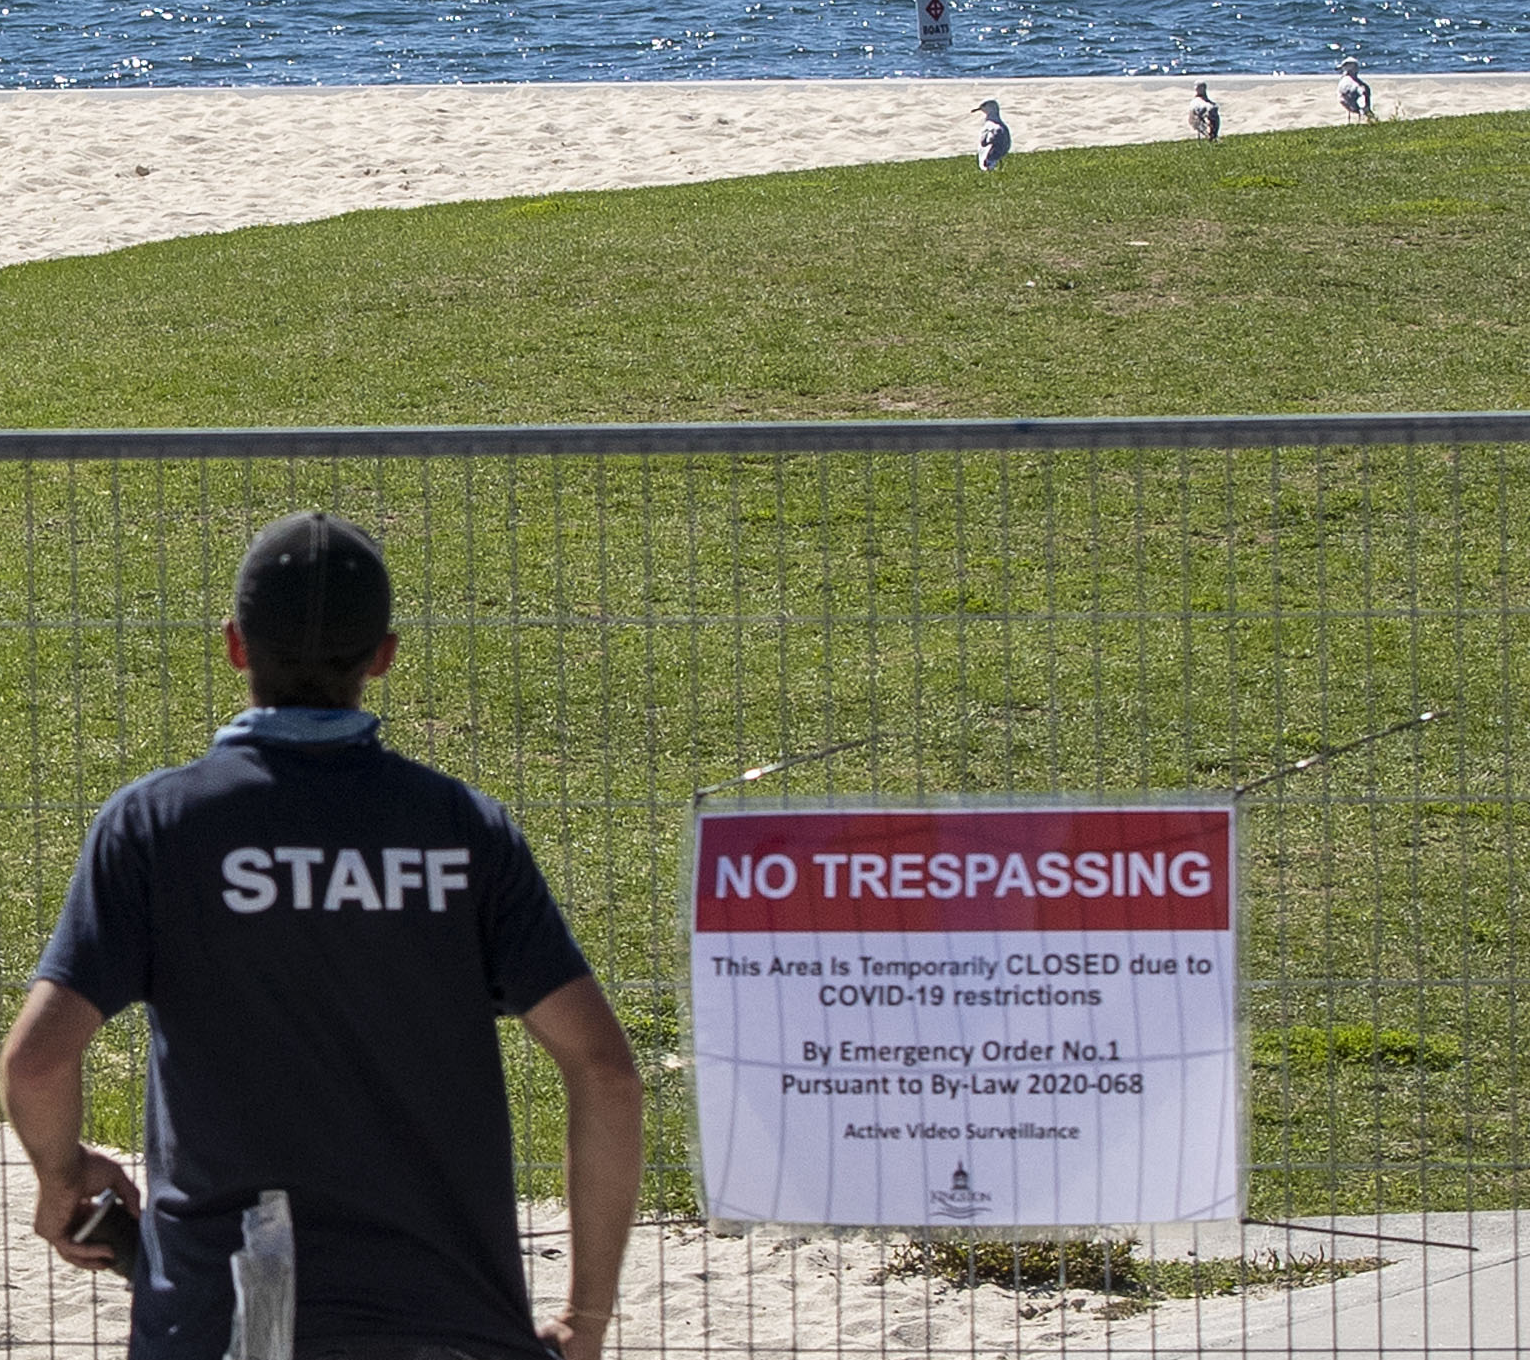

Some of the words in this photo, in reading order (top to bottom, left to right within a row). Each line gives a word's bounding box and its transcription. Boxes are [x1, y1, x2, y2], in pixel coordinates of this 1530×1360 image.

[221, 846, 471, 914] STAFF
[715, 853, 797, 900] NO
[814, 850, 1212, 899] TRESPASSING
[713, 957, 762, 977] This
[768, 957, 823, 977] Area
[830, 957, 851, 976] Is
[860, 955, 999, 980] Temporarily
[1005, 953, 1121, 977] CLOSED
[1129, 953, 1178, 975] due
[1186, 955, 1213, 975] to
[819, 984, 945, 1007] COVID-19
[952, 984, 1103, 1007] restrictions
[802, 1041, 832, 1066] By
[840, 1041, 974, 1067] Emergency
[982, 1040, 1055, 1063] Order
[1062, 1040, 1121, 1062] No.1
[782, 1074, 890, 1096] Pursuant
[898, 1075, 923, 1096] to
[930, 1074, 1020, 1099] By-Law
[1027, 1073, 1144, 1095] 2020-068
[843, 1123, 901, 1140] Active
[905, 1123, 960, 1140] Video
[965, 1122, 1081, 1140] Surveillance
